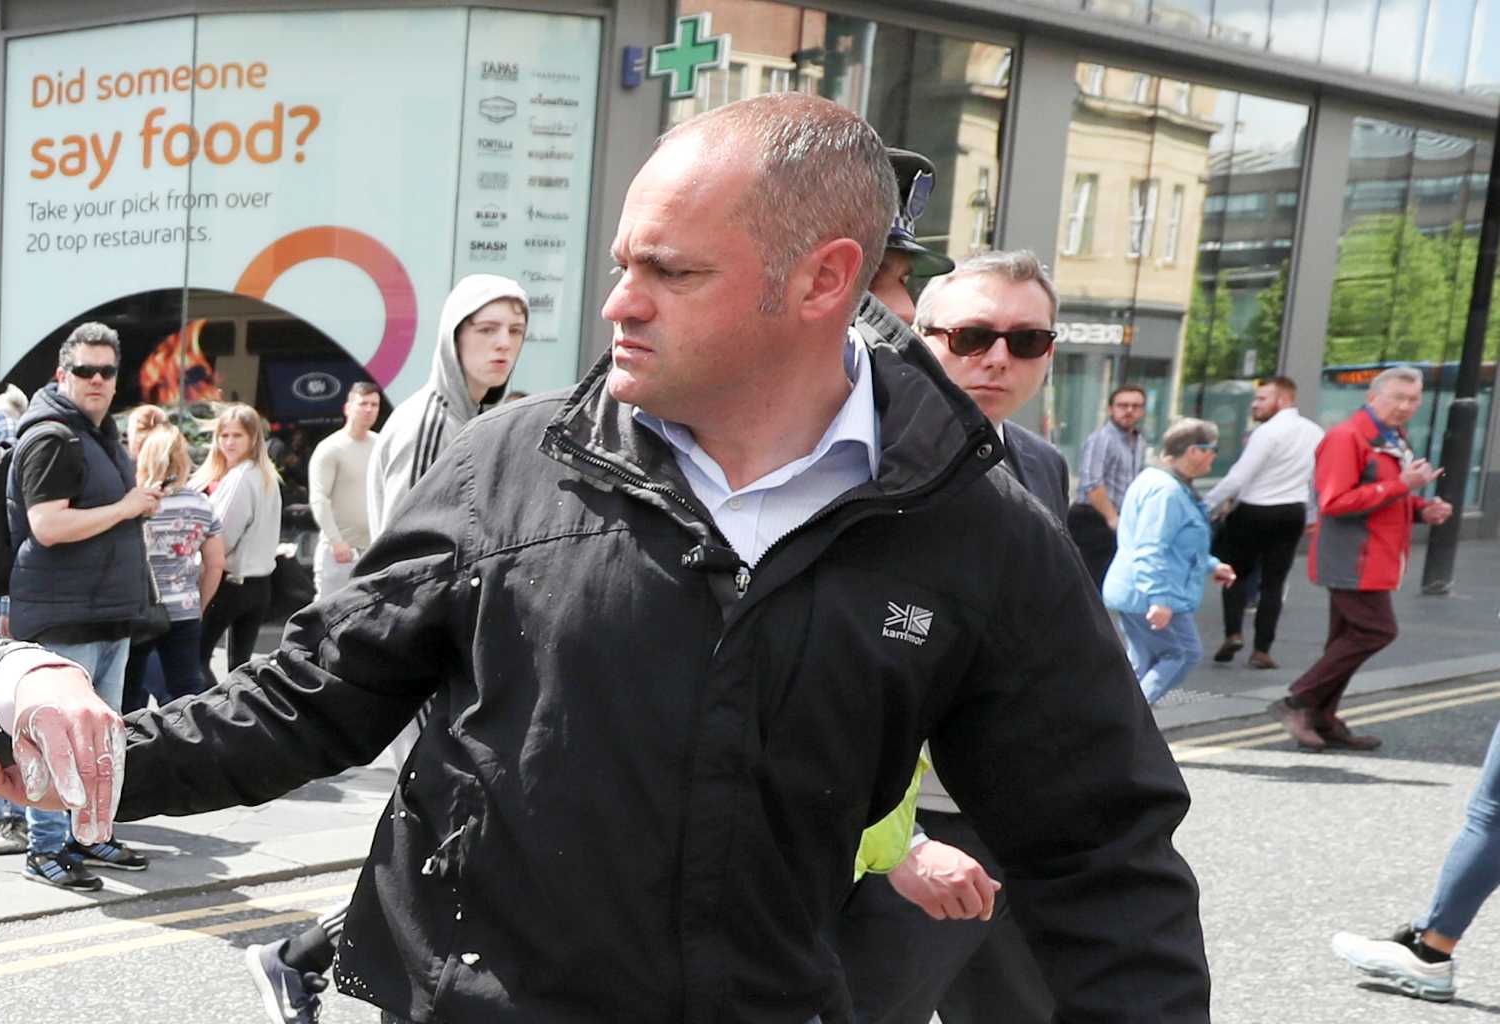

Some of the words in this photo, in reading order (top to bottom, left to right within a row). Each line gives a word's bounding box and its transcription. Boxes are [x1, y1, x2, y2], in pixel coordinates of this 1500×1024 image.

[32, 67, 85, 108] Did
[97, 60, 268, 101] someone
[30, 131, 122, 190] say
[140, 102, 321, 169] food?
[28, 200, 68, 221] Take
[73, 200, 116, 223] your
[122, 191, 160, 219] pick
[167, 188, 218, 210] from
[225, 191, 273, 209] over
[27, 232, 51, 253] 20
[57, 234, 88, 254] top
[94, 225, 212, 248] restaurants.
[470, 240, 507, 251] SMASH
